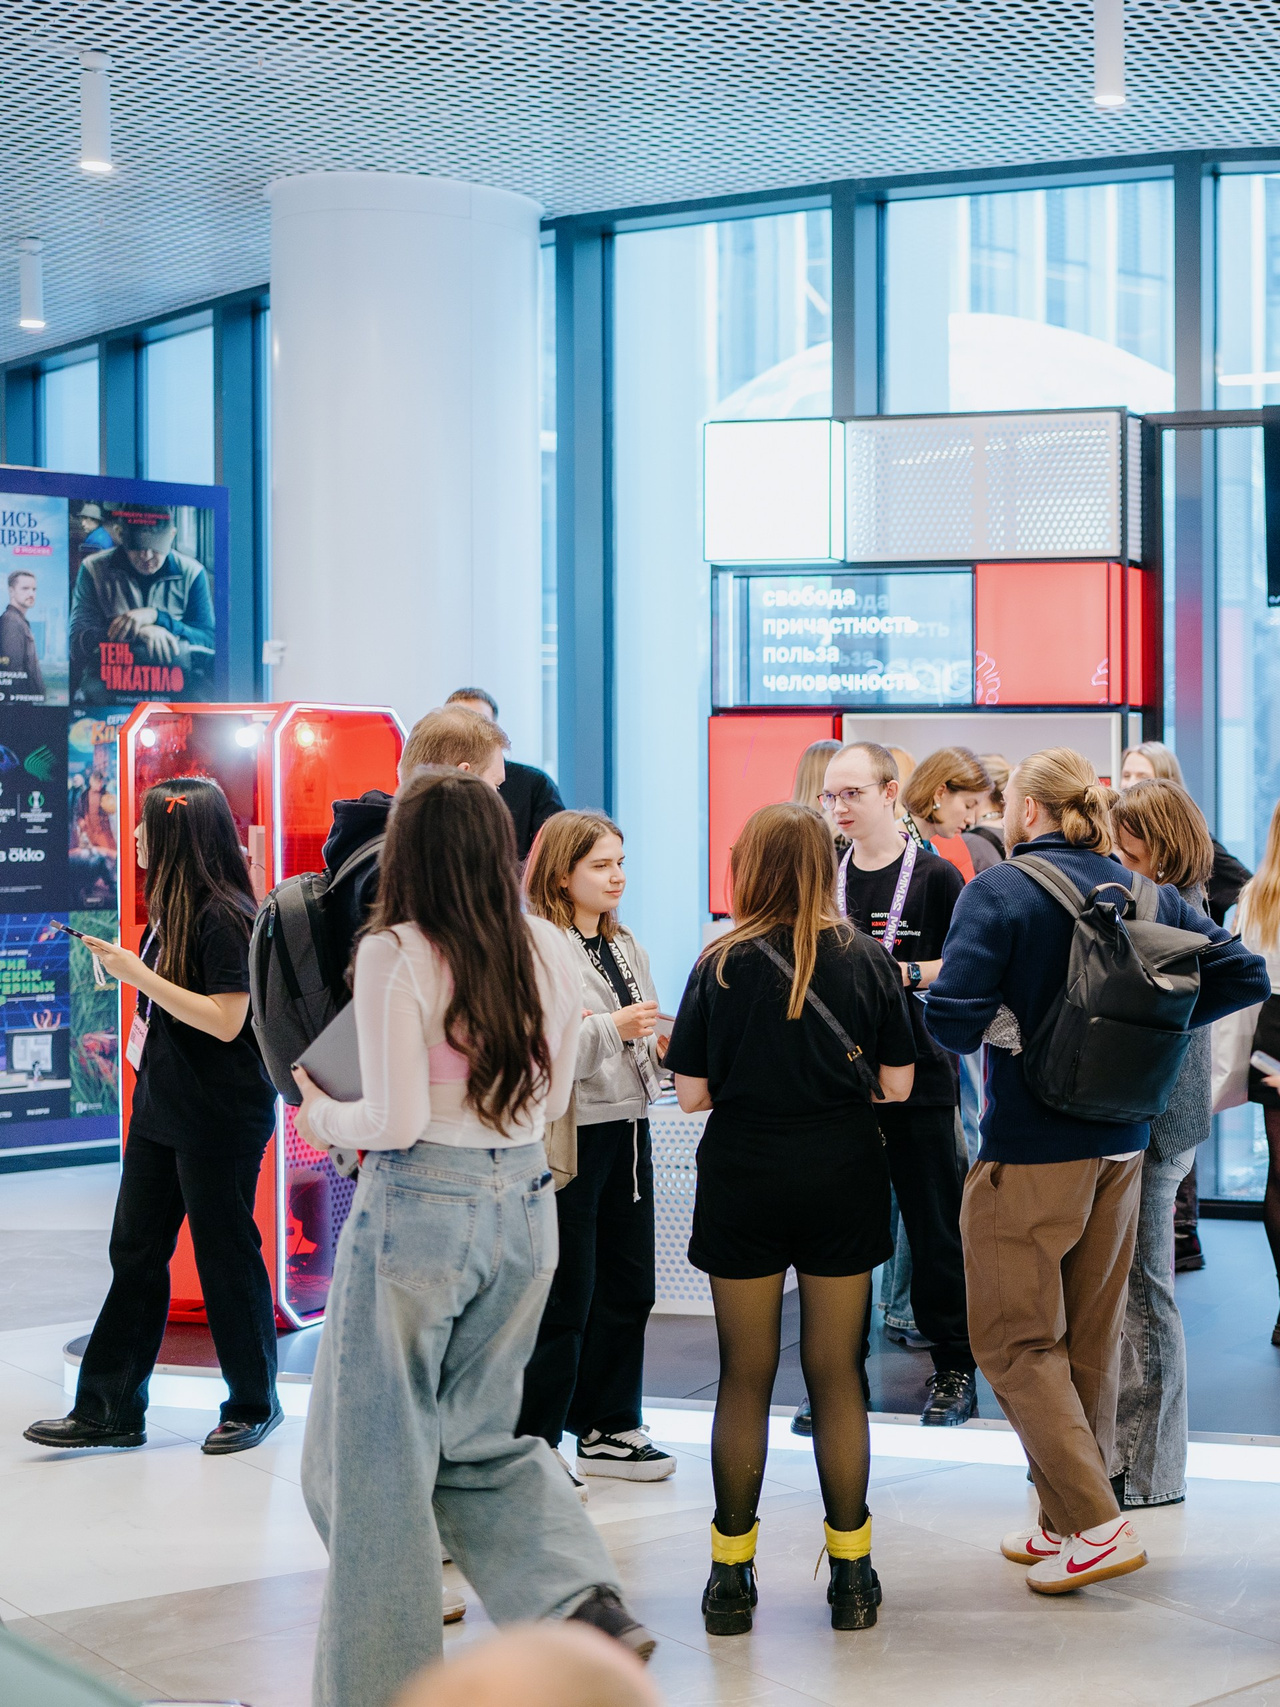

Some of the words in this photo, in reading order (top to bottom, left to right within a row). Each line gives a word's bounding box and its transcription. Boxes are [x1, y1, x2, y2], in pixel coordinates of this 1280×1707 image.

[763, 585, 856, 609] свобода
[763, 616, 919, 640] причастность
[99, 642, 134, 664] ТЕНЬ
[763, 645, 840, 664] польза
[100, 665, 184, 692] ЧИКАТИЛО
[763, 673, 921, 692] человечность
[893, 871, 909, 911] MMAS
[884, 916, 899, 949] MMA
[609, 942, 632, 980] MMAS
[0, 970, 42, 982] СКИХ
[0, 981, 55, 994] ЕРНЫХ
